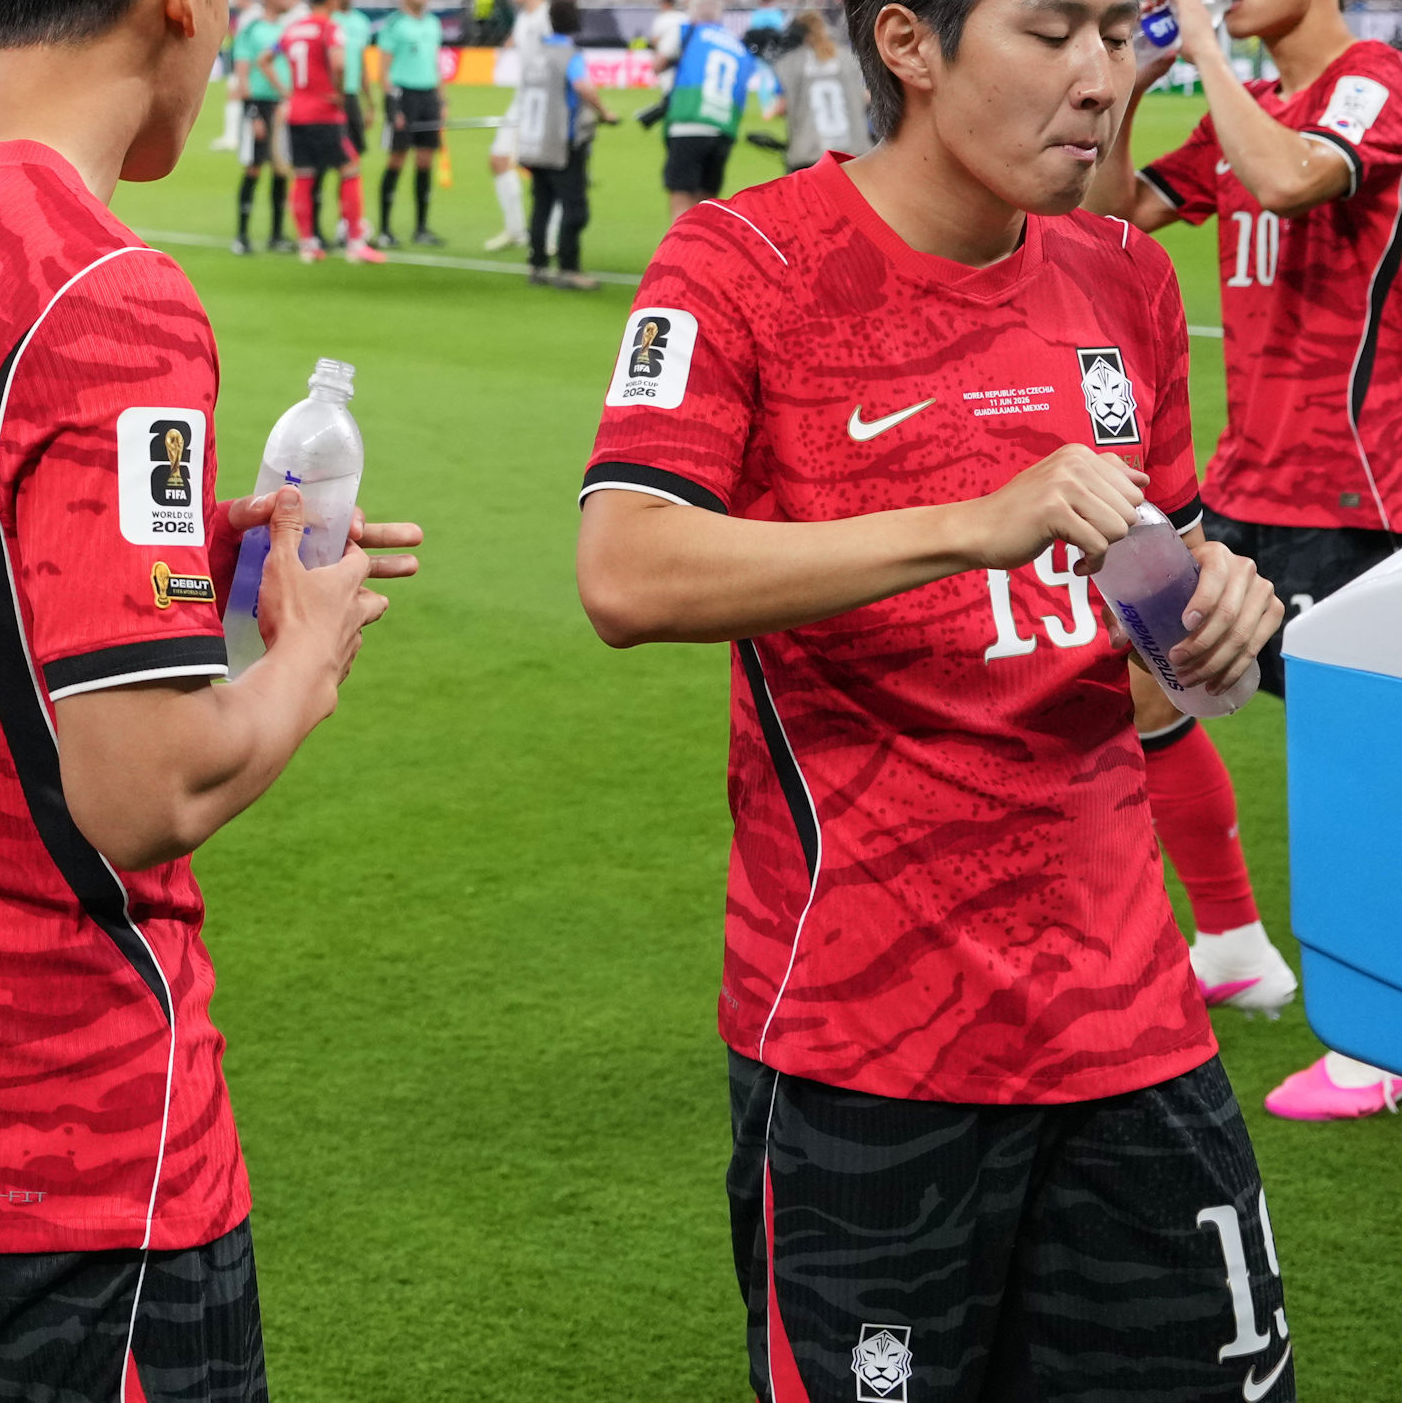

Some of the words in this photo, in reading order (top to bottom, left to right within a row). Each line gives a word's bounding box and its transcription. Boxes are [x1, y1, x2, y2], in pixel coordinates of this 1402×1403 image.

[1227, 210, 1280, 288] 10
[634, 364, 650, 374] FIFA
[626, 380, 642, 388] WORLD
[623, 387, 656, 398] 2026
[963, 392, 985, 401] KOREA
[985, 388, 1017, 399] REPUBLIC
[1026, 385, 1055, 394] CZECHIA
[989, 399, 998, 407] 11
[999, 398, 1013, 406] JUN
[1013, 396, 1030, 405] 2026
[974, 405, 1022, 417] GUADALAJARA,
[1023, 403, 1050, 412] MEXICO
[165, 489, 188, 500] FIFA
[151, 510, 183, 519] WORLD
[152, 521, 194, 534] 2026
[170, 578, 209, 590] DEBUT
[984, 542, 1097, 666] 19
[1116, 599, 1185, 692] smartwater
